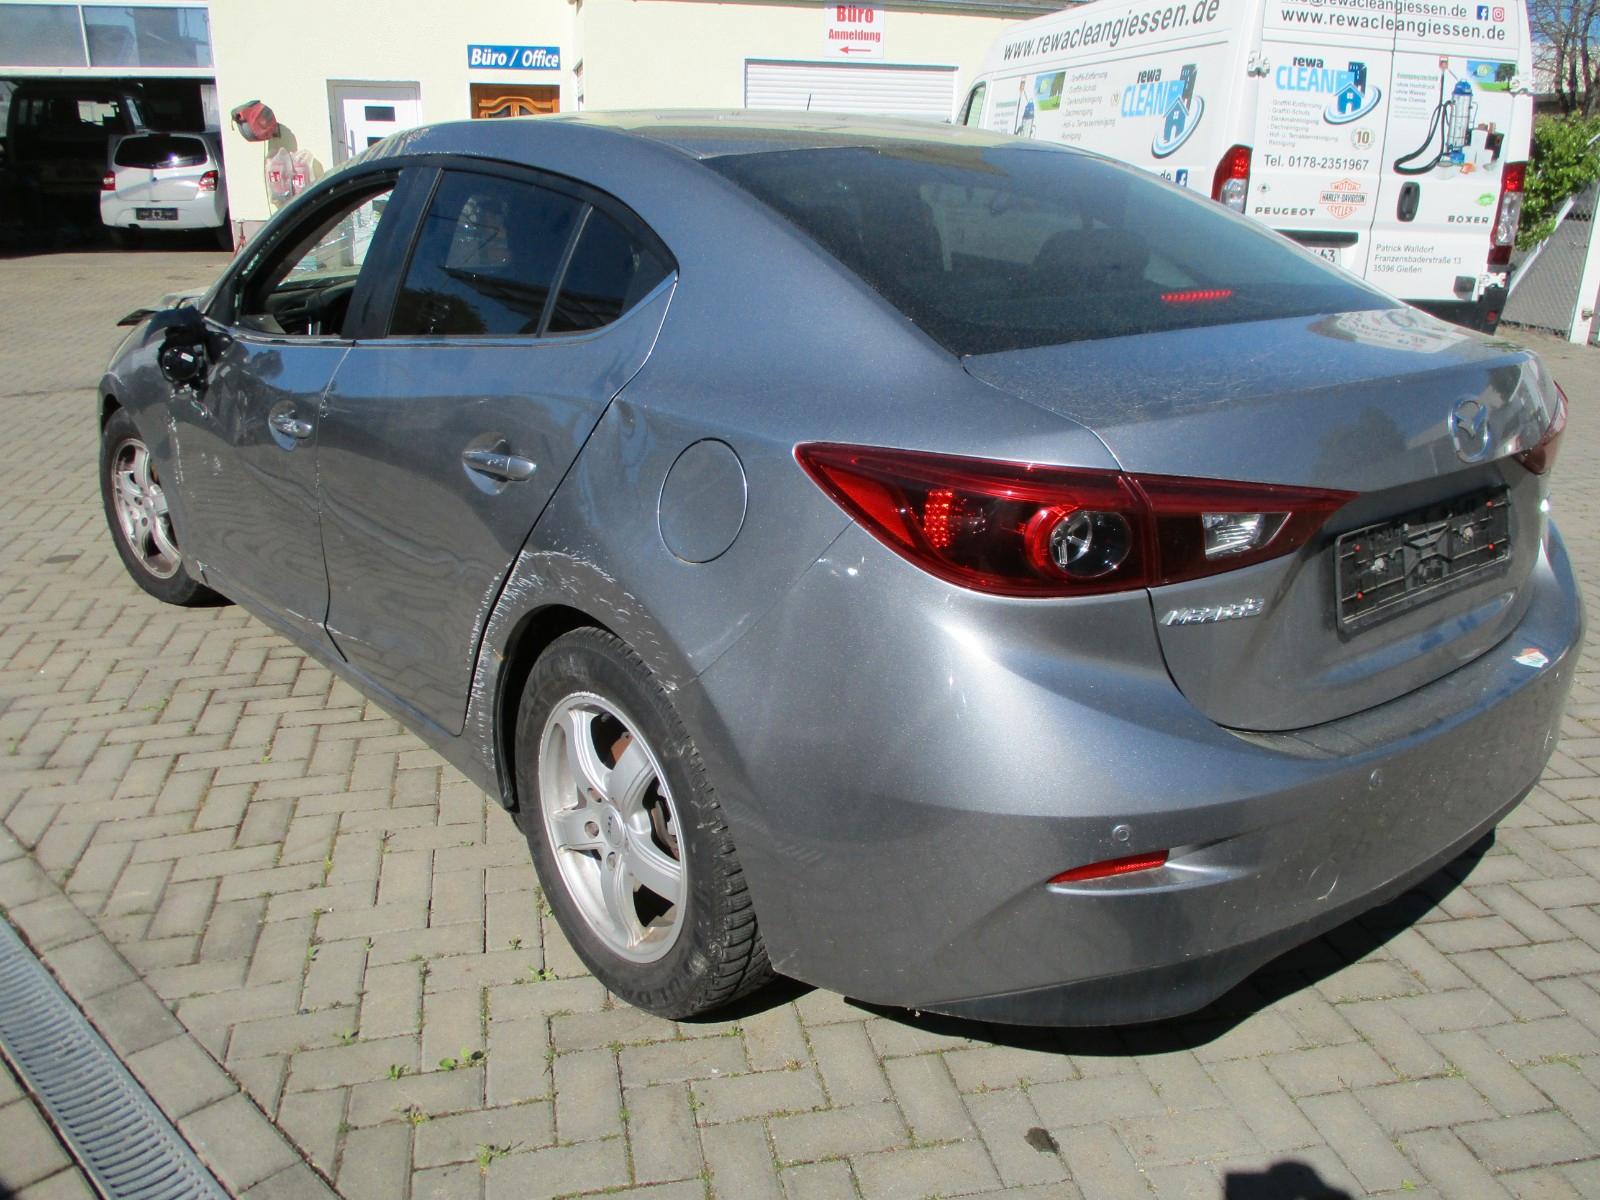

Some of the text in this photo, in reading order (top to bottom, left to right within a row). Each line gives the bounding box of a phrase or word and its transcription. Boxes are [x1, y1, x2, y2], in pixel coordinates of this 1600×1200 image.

[837, 4, 874, 23] Büro
[1282, 0, 1467, 17] @rewacleangiessen.de
[1003, 0, 1220, 61] www.rewacleangiessen.de
[1281, 9, 1505, 40] www.rewacleangiessen.de
[829, 28, 881, 43] Anmeldung
[471, 48, 507, 66] Büro
[522, 49, 559, 67] Office
[1293, 56, 1324, 69] rewa
[1137, 68, 1162, 84] rewa
[1276, 65, 1334, 93] CLEAN
[1121, 82, 1168, 117] CLEAN
[1357, 131, 1370, 144] 10
[1264, 154, 1369, 171] Tel. 0178-2351967
[1255, 206, 1316, 216] PEUGEOT
[1447, 215, 1489, 224] BOXER
[1376, 243, 1402, 252] Patrick
